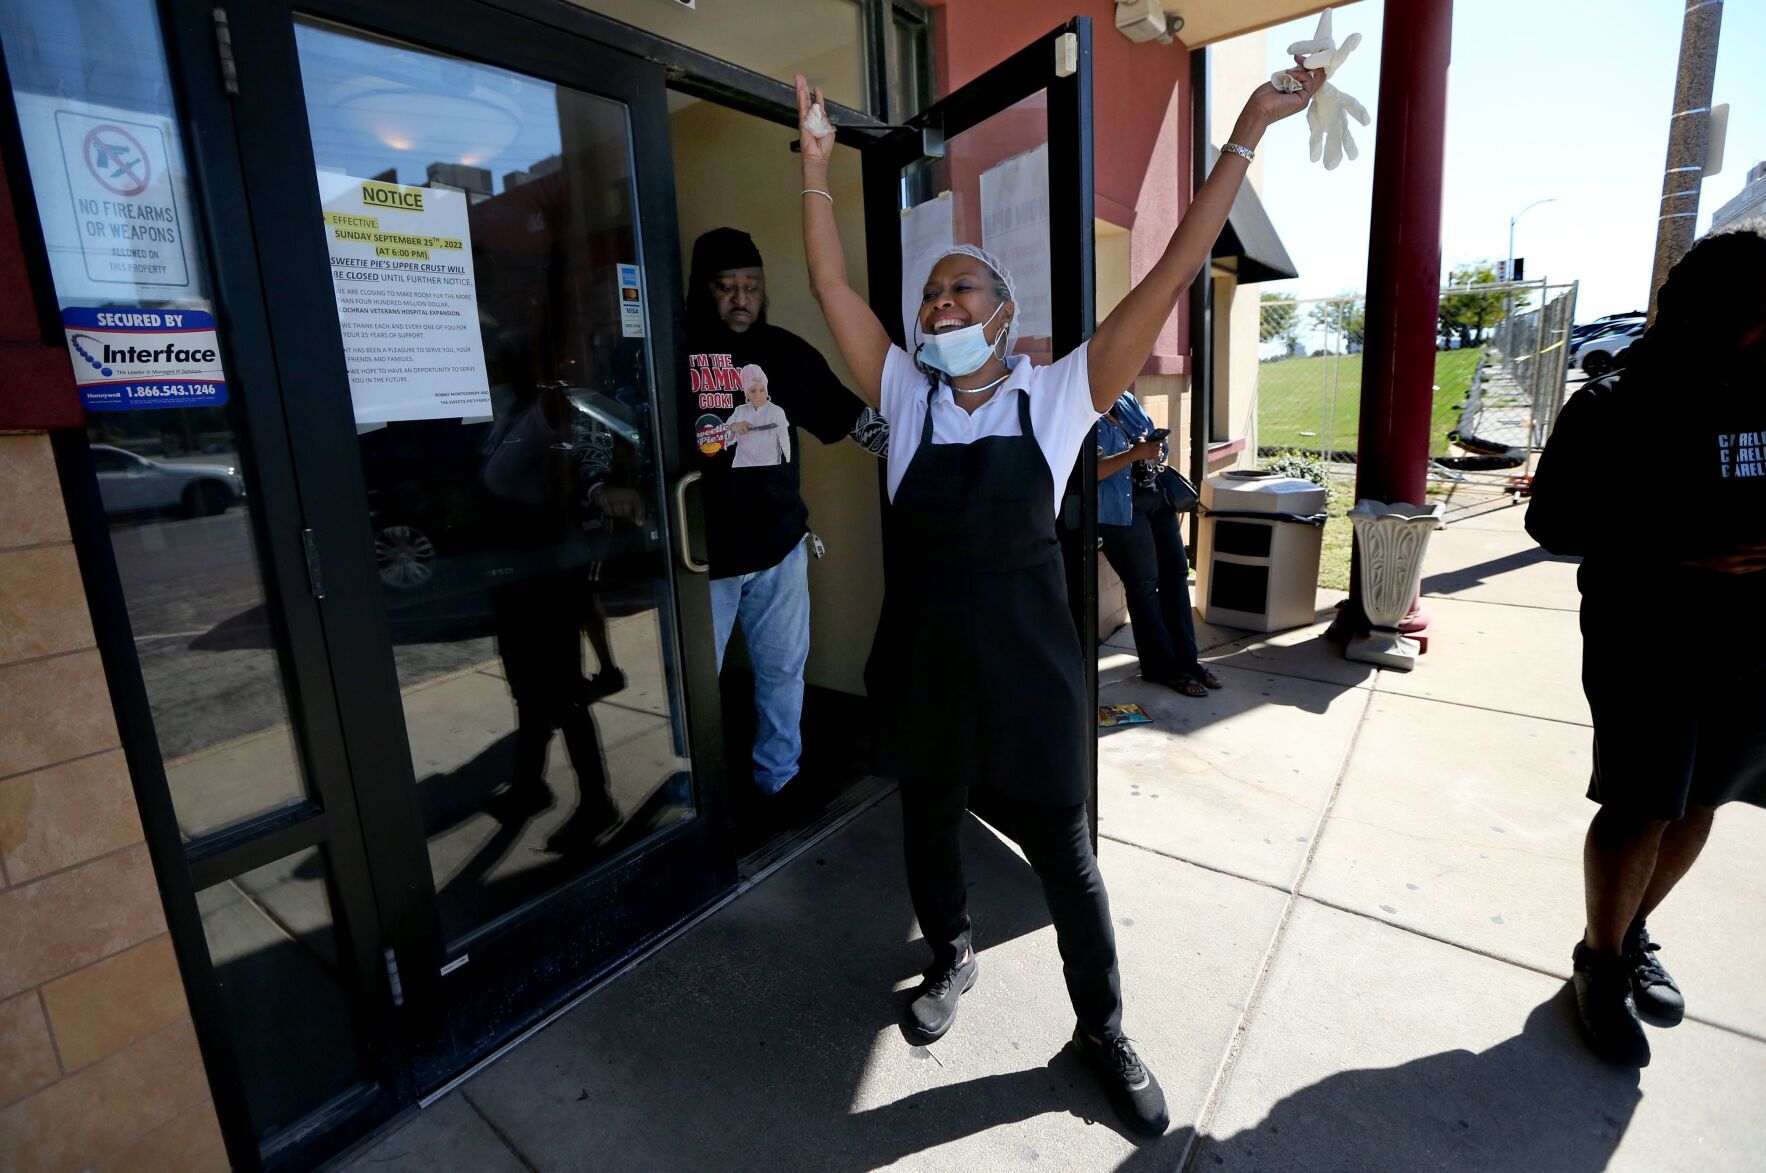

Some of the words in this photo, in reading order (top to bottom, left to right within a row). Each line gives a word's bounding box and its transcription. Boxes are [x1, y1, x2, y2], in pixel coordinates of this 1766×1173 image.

[362, 186, 423, 208] NOTICE
[80, 199, 98, 215] NO
[103, 202, 174, 222] FIREARMS
[332, 216, 379, 228] EFFECTIVE:
[86, 221, 106, 237] OR
[110, 223, 175, 243] WEAPONS
[335, 230, 372, 241] SUNDAY
[374, 231, 422, 246] SEPTEMBER
[444, 240, 463, 249] 2022
[112, 248, 147, 258] ALLOWED
[149, 250, 160, 259] ON
[376, 247, 389, 257] (AT
[392, 248, 410, 258] 6:00
[128, 264, 166, 274] PROPERTY
[330, 257, 368, 267] SWEETIE
[370, 260, 390, 268] PIE'S
[392, 262, 418, 271] UPPER
[420, 264, 446, 272] CRUST
[448, 266, 466, 274] WILL
[346, 272, 378, 281] CLOSED
[381, 274, 406, 282] UNTIL
[407, 276, 442, 284] FURTHER
[444, 278, 473, 286] NOTICE.
[97, 312, 161, 327] SECURED
[164, 314, 184, 328] BY
[104, 343, 216, 364] Interface
[689, 353, 709, 368] I'M
[708, 353, 734, 368] THE
[690, 366, 744, 392] DAMN
[126, 384, 216, 398] 1.866.543.1246
[698, 392, 734, 409] COOK!
